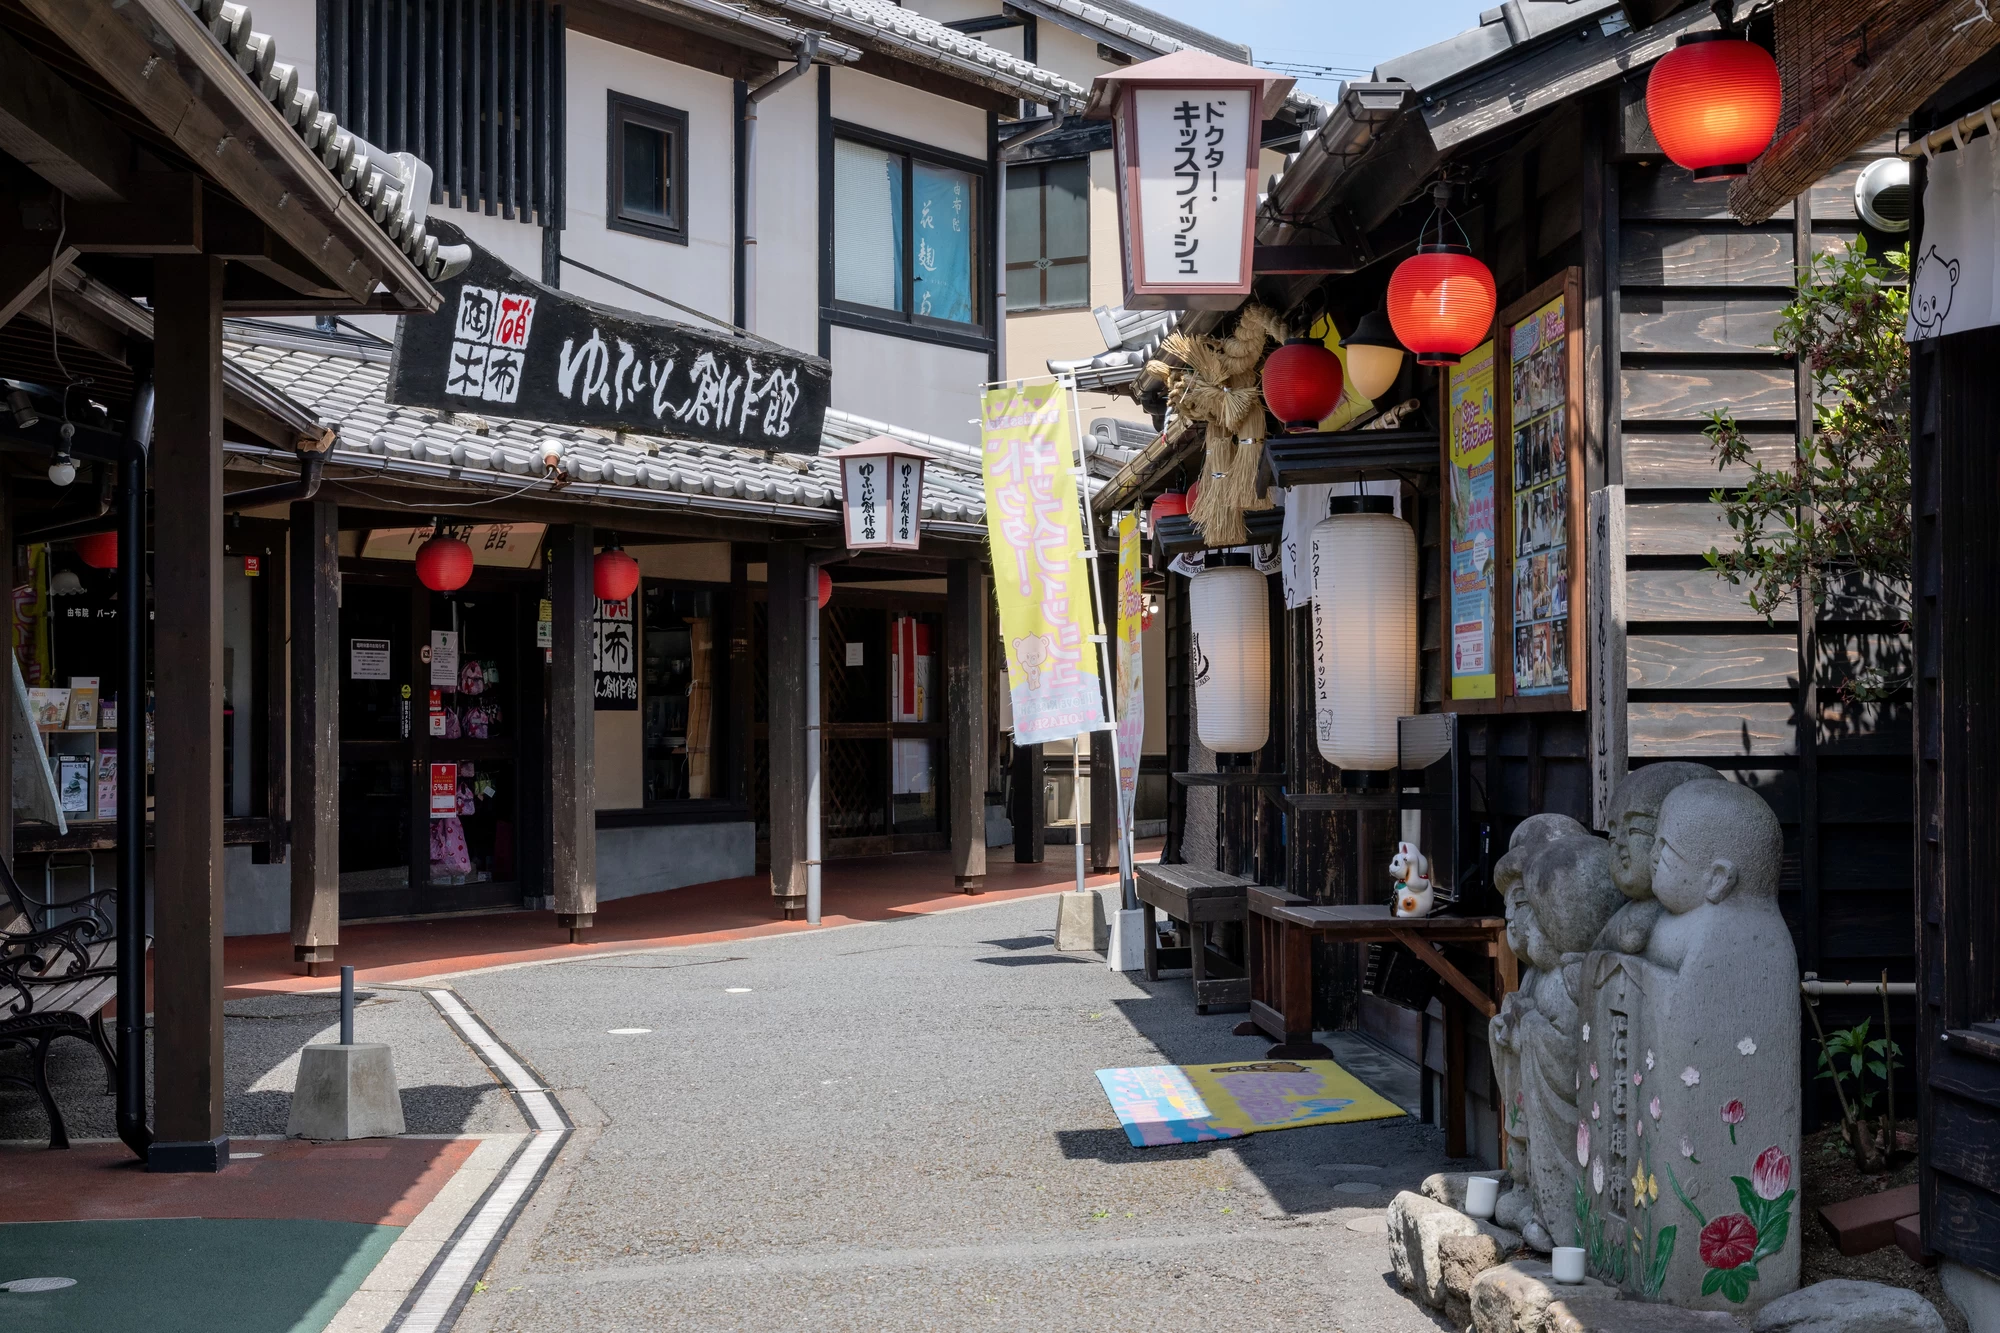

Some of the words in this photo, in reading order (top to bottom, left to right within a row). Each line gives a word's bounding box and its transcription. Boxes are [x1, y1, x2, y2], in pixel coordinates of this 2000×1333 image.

[1173, 100, 1200, 275] キッスフィッシュ
[557, 327, 799, 438] ゆふいん創作館
[67, 607, 90, 618] 由布院
[433, 783, 454, 791] 5%還元
